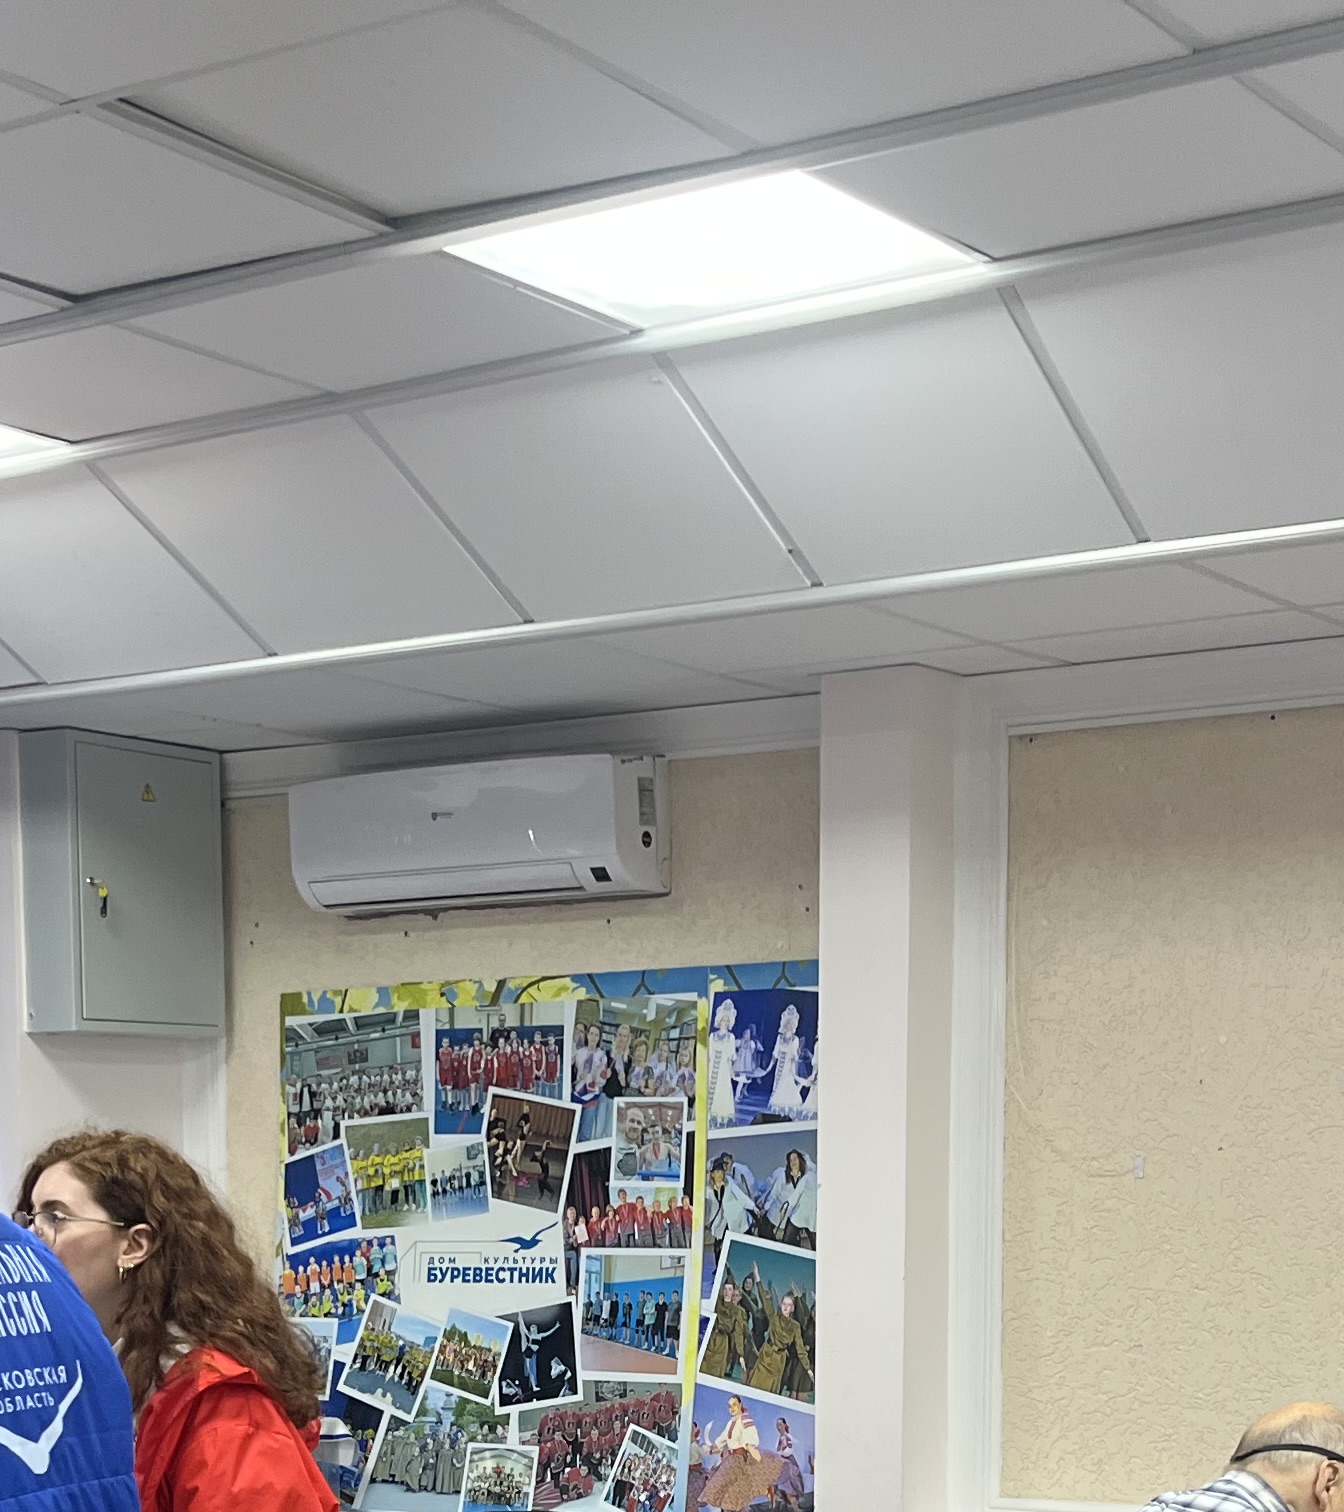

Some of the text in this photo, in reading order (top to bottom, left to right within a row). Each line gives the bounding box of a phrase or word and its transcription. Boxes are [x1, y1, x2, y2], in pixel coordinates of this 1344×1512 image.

[427, 1256, 558, 1265] ДОМ КУЛЬТУРЫ
[427, 1266, 557, 1284] БУРЕВЕСТНИК
